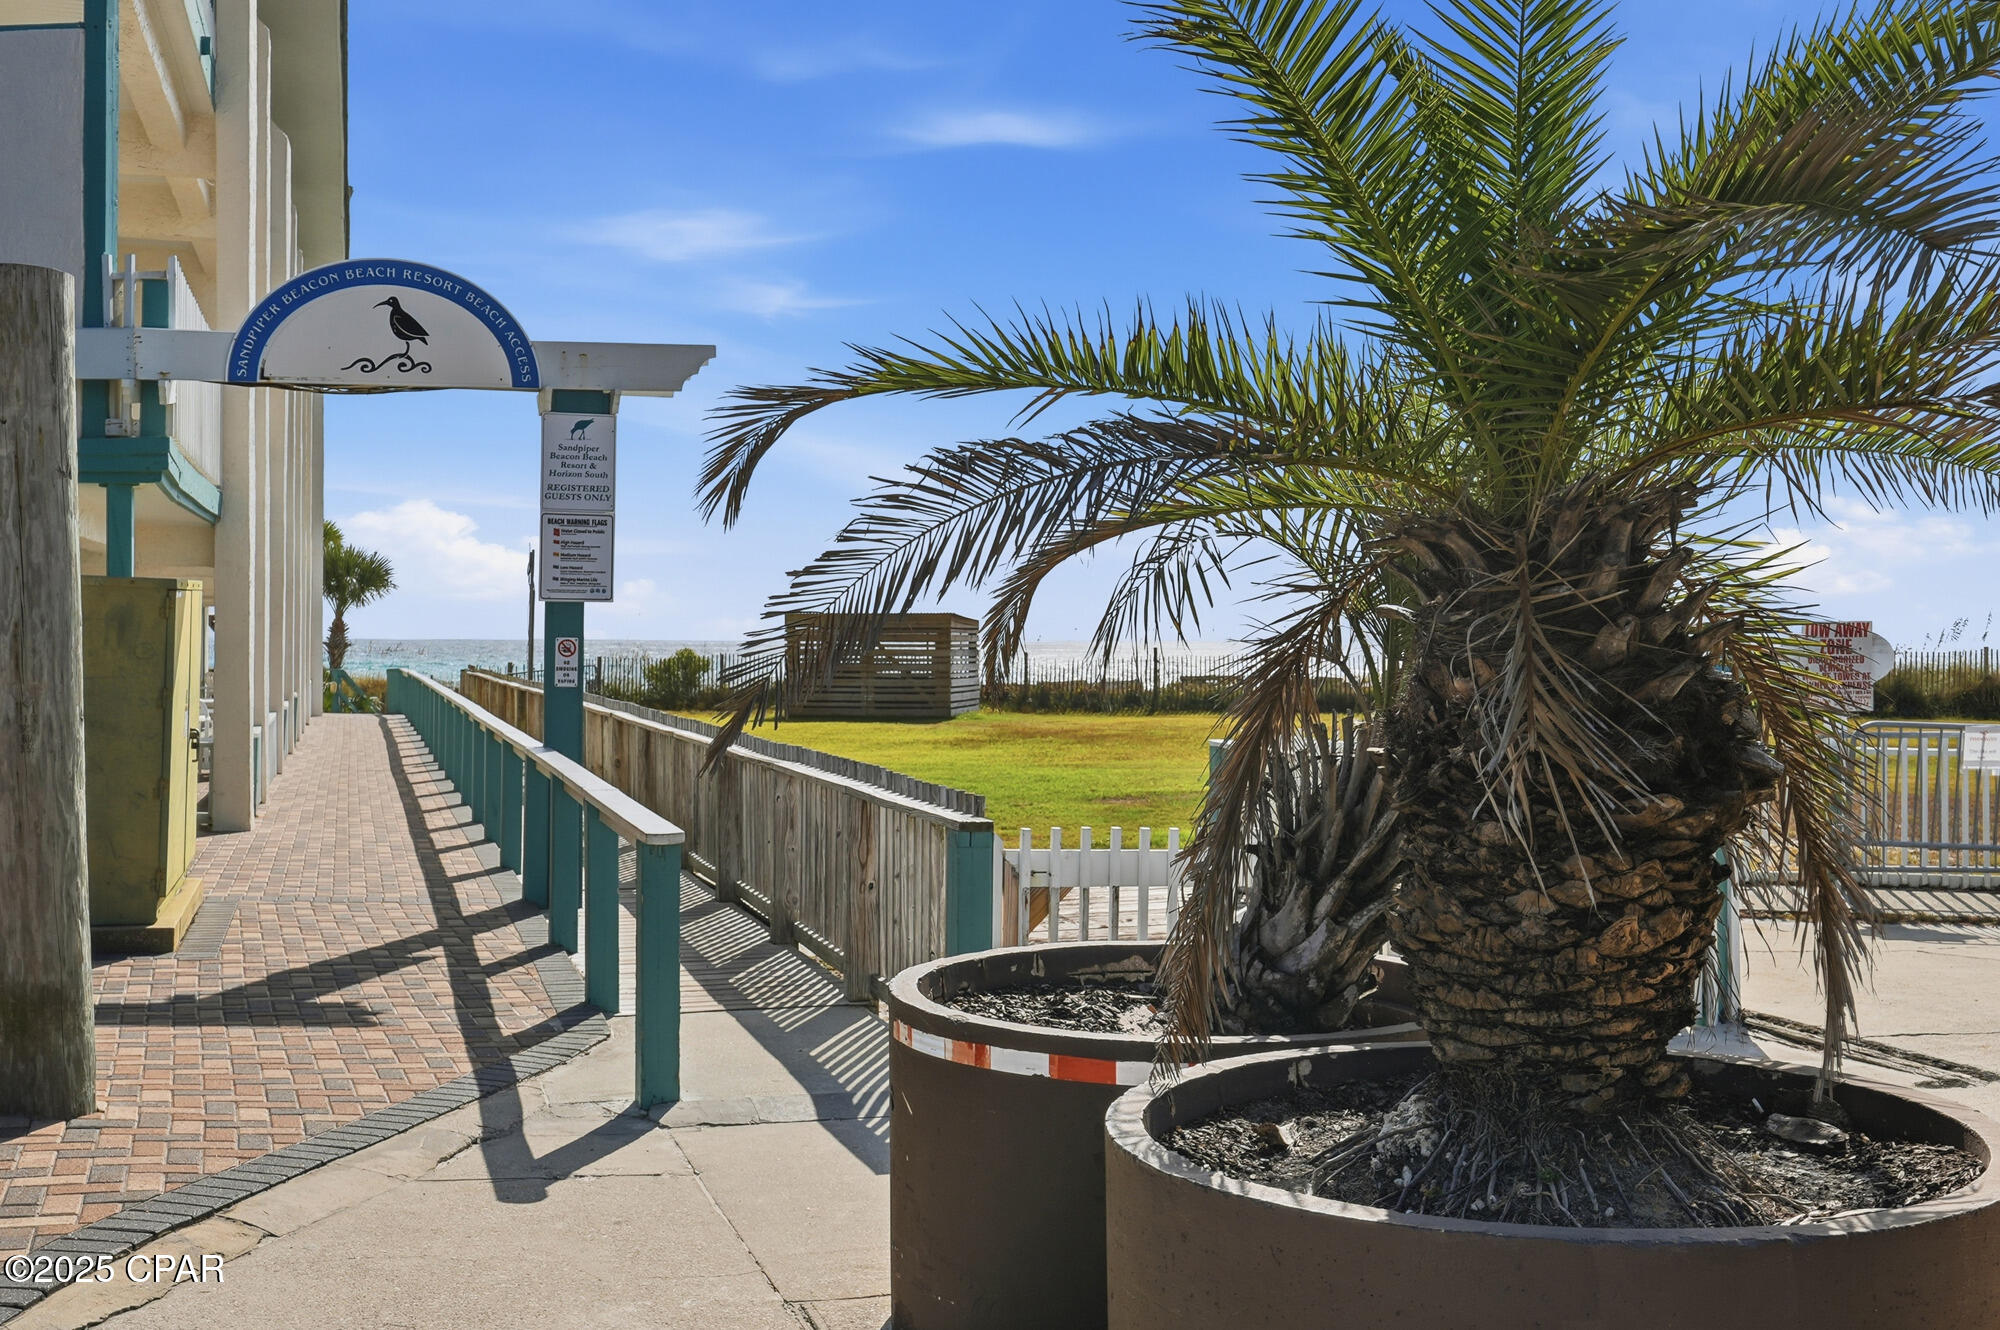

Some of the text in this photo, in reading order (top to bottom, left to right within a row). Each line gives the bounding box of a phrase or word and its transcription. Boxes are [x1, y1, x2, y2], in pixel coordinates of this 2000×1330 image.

[237, 266, 532, 382] SANDPIPER BEACON BEACH RESORT BEACH ACCESS
[558, 443, 600, 453] Sandpiper
[550, 452, 608, 461] Beacon Beach
[560, 461, 597, 470] Resort &
[548, 469, 609, 479] Horizon South
[546, 483, 610, 493] REGISTERED
[544, 492, 612, 502] GUESTS ONLY
[566, 518, 590, 526] WARNING
[591, 519, 608, 527] FLAGS
[1805, 621, 1870, 638] TOW AWAY
